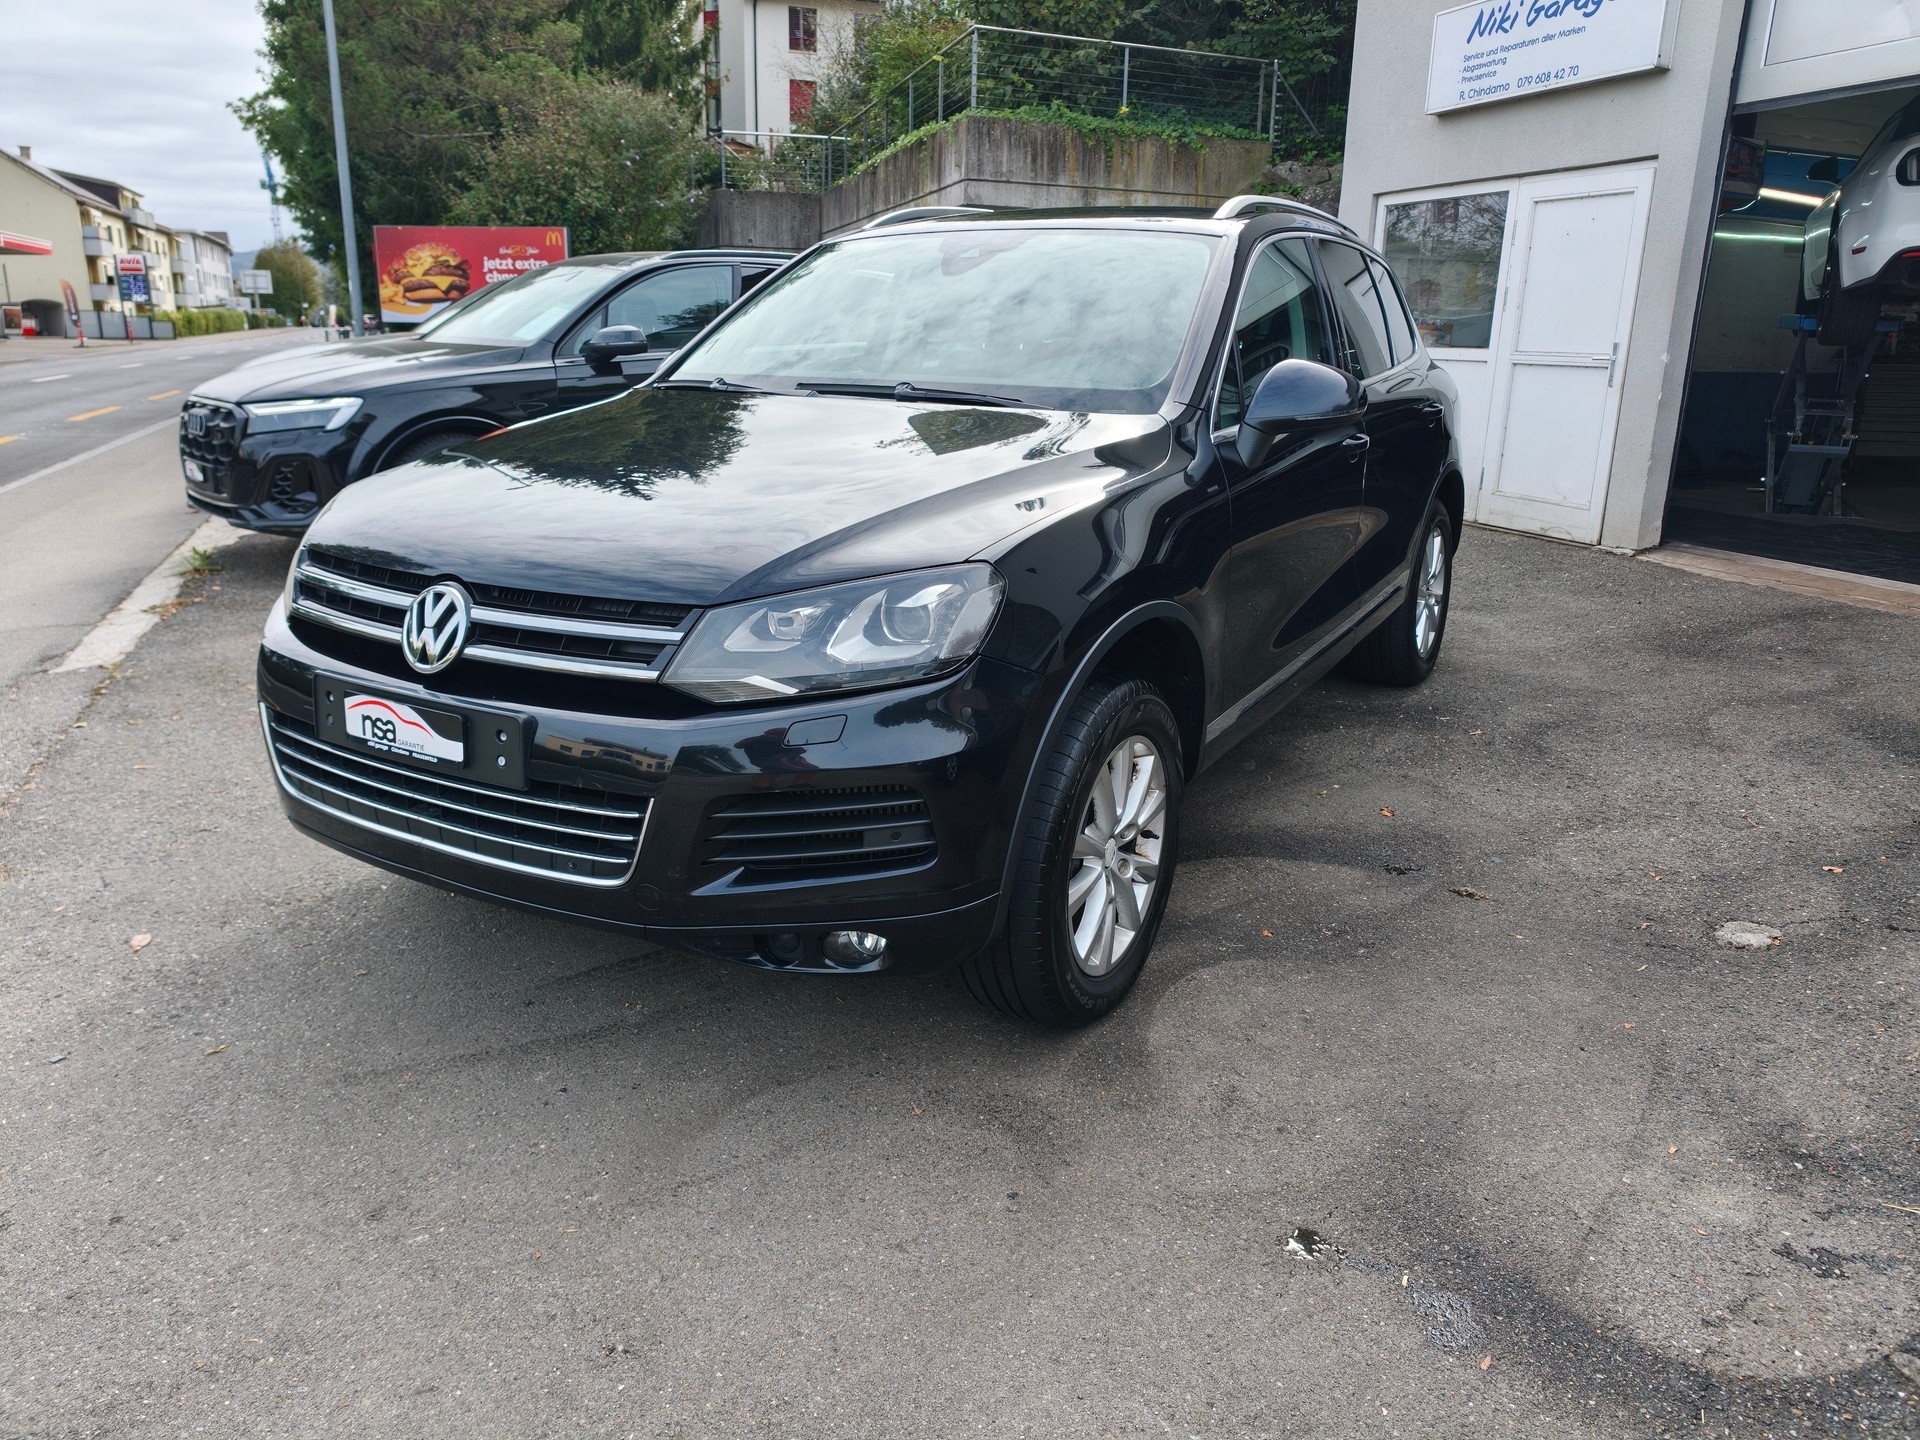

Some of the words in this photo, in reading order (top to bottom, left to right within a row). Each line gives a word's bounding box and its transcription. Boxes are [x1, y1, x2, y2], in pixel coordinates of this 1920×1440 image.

[1466, 0, 1524, 44] Niki
[1526, 0, 1615, 27] Garag
[1463, 51, 1485, 63] Service
[1486, 47, 1499, 57] und
[1500, 37, 1540, 54] Reparaturen
[1541, 33, 1557, 43] aller
[1558, 25, 1586, 39] Marken
[1461, 70, 1497, 84] Pneuservice
[1462, 57, 1507, 73] Abgaswartung
[1468, 82, 1510, 98] Chindamo
[1517, 75, 1534, 88] 079
[1534, 71, 1552, 84] 608
[1553, 68, 1566, 80] 42
[1567, 65, 1580, 77] 70
[483, 256, 514, 272] jetzt
[515, 258, 549, 269] extra
[361, 713, 397, 744] nsa
[398, 739, 425, 751] GARANTIE
